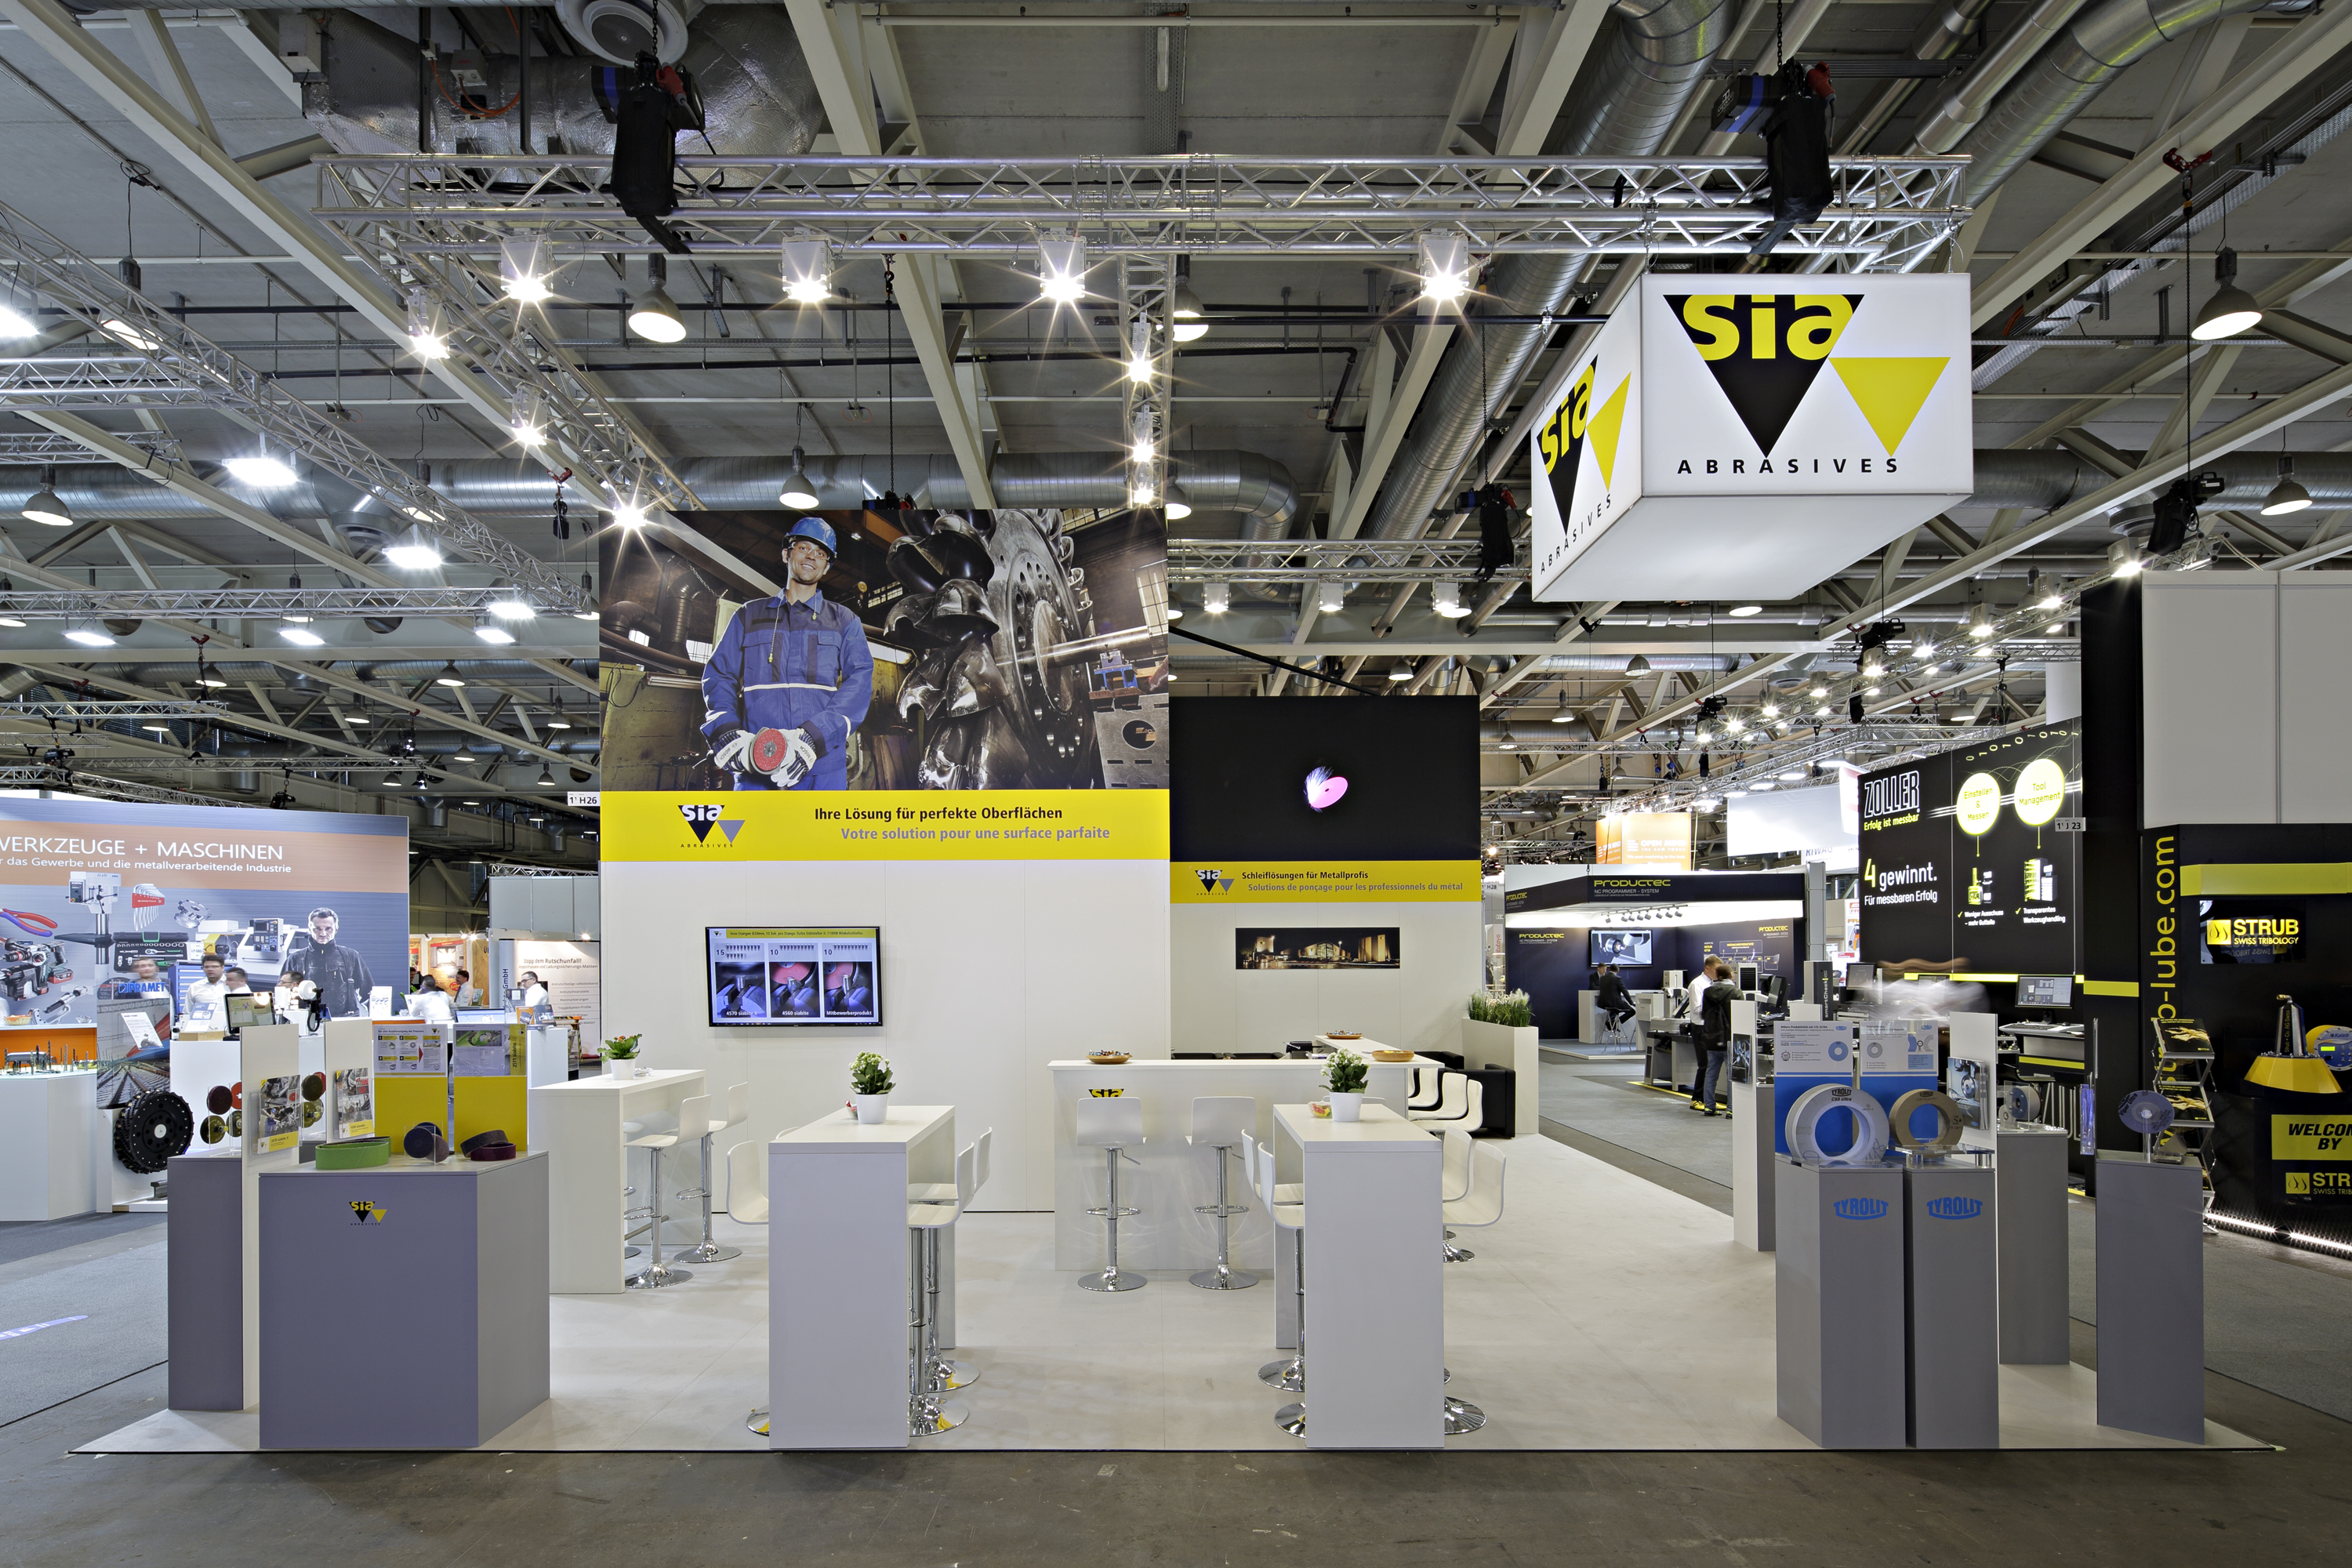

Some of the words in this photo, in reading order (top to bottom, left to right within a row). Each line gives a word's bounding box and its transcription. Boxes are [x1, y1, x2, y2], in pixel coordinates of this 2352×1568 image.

[1682, 295, 1853, 361] sia
[1541, 363, 1595, 477] sia
[1677, 458, 1898, 474] ABRASIVES
[1539, 492, 1612, 575] ABRASIVES
[1864, 770, 1919, 818] ZOLLER
[1964, 786, 1993, 800] Einstellen
[2033, 782, 2046, 792] Tool
[2019, 791, 2061, 807] Management
[681, 804, 724, 822] sia
[815, 808, 841, 820] Ihre
[845, 808, 892, 822] Lösung
[896, 808, 916, 820] für
[920, 808, 977, 822] perfekte
[982, 807, 1063, 819] Oberflächen
[1968, 811, 1990, 822] Messen
[1864, 818, 1882, 831] Erfolg
[1893, 813, 1919, 826] messbar
[841, 828, 878, 840] Votre
[882, 827, 936, 840] solution
[940, 829, 971, 842] pour
[975, 829, 1000, 839] une
[1004, 827, 1052, 839] surface
[1056, 826, 1110, 842] parfaite
[157, 841, 283, 860] MASCHINEN
[7, 858, 27, 866] das
[31, 858, 84, 868] Gewerbe
[87, 859, 110, 869] und
[113, 860, 131, 869] die
[135, 860, 243, 872] metallverarbeitende
[246, 863, 292, 873] Industrie
[1197, 870, 1222, 880] sia
[1242, 871, 1304, 881] Schleiflösungen
[1306, 871, 1317, 880] für
[1320, 870, 1368, 881] Metallprofis
[1864, 858, 1875, 888] 4
[1879, 862, 1937, 891] gewinnt.
[1299, 884, 1332, 894] ponçage
[1369, 883, 1425, 891] professionnels
[1440, 882, 1462, 891] métal
[1864, 894, 1875, 906] Für
[1876, 892, 1915, 905] messbaren
[1916, 890, 1937, 902] Erfolg
[2024, 906, 2056, 915] Transparentes
[2024, 915, 2066, 924] Werkzeughandling
[2234, 918, 2299, 935] STRUB
[129, 982, 165, 993] PRAMET
[1831, 1088, 1853, 1097] TYROLIT
[2318, 1138, 2343, 1150] BY
[350, 1201, 374, 1211] sia
[1833, 1197, 1889, 1220] TYROLIT
[1927, 1196, 1983, 1220] TYROLIT
